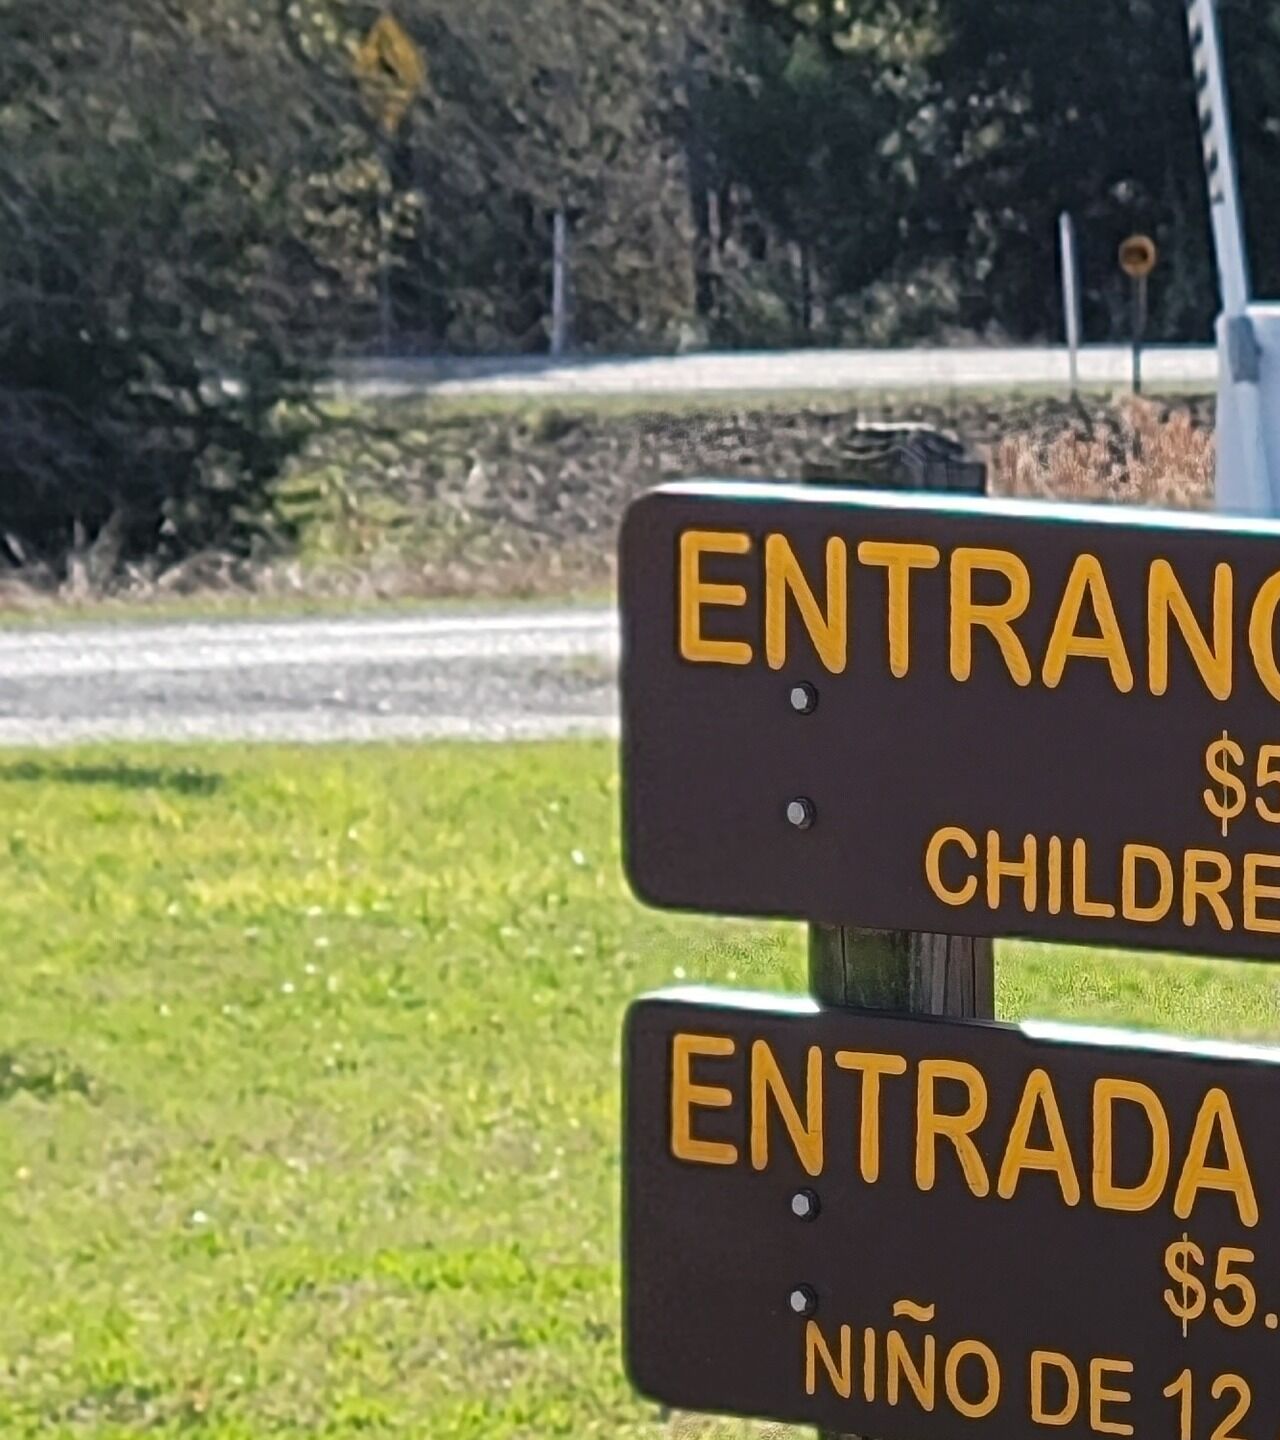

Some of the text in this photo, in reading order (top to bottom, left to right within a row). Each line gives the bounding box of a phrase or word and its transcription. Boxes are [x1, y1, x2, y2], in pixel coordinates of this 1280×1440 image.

[672, 1033, 1258, 1226] ENTRADA
[806, 1300, 1000, 1418] NIÑO
[1031, 1351, 1130, 1436] DE
